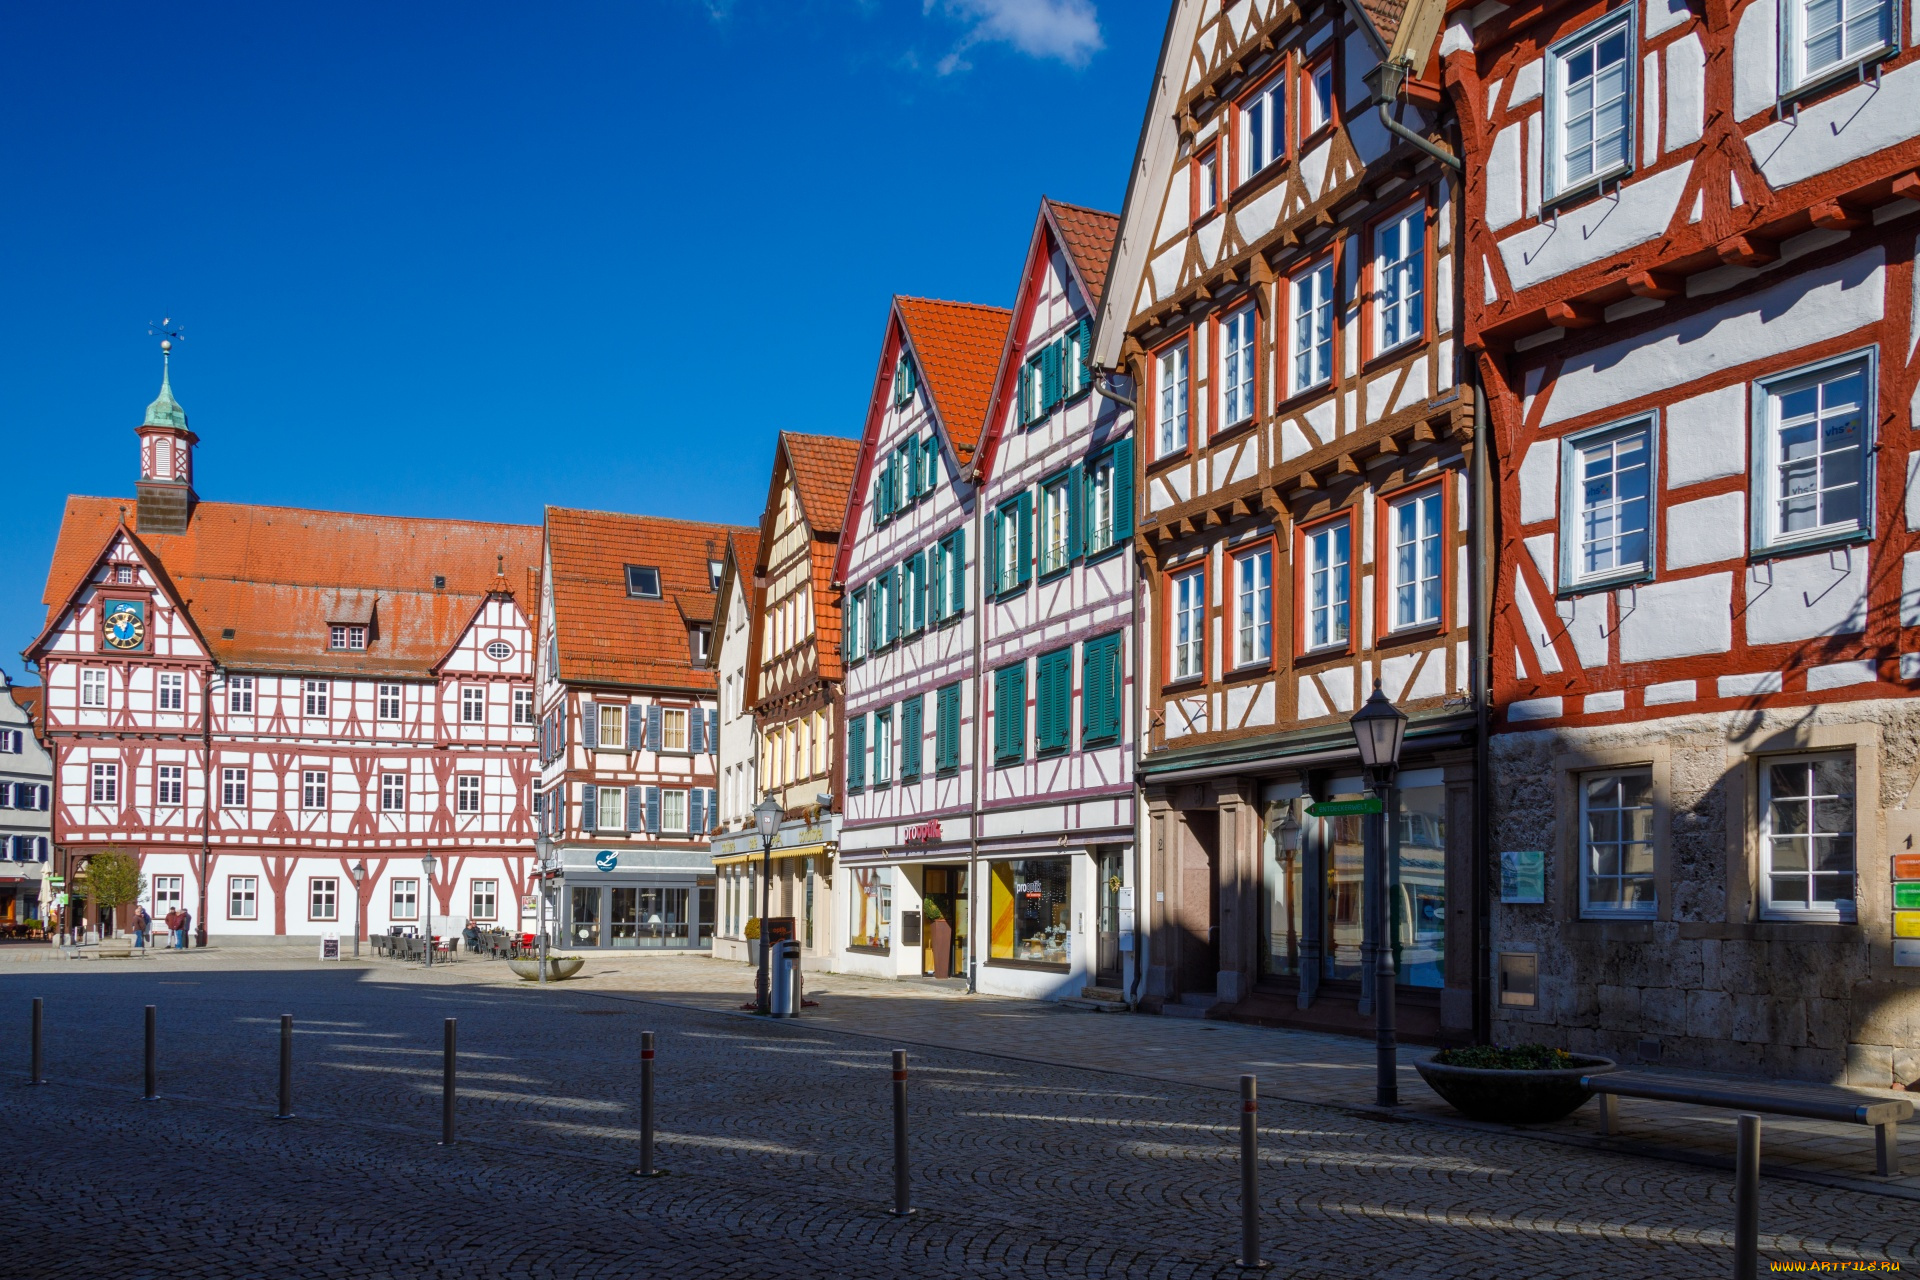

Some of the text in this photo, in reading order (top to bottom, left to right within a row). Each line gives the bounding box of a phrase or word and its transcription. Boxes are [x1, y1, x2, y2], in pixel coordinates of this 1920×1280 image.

[1318, 804, 1367, 813] ENTDECKERWELT
[1157, 839, 1163, 851] 2
[1903, 834, 1912, 849] 1
